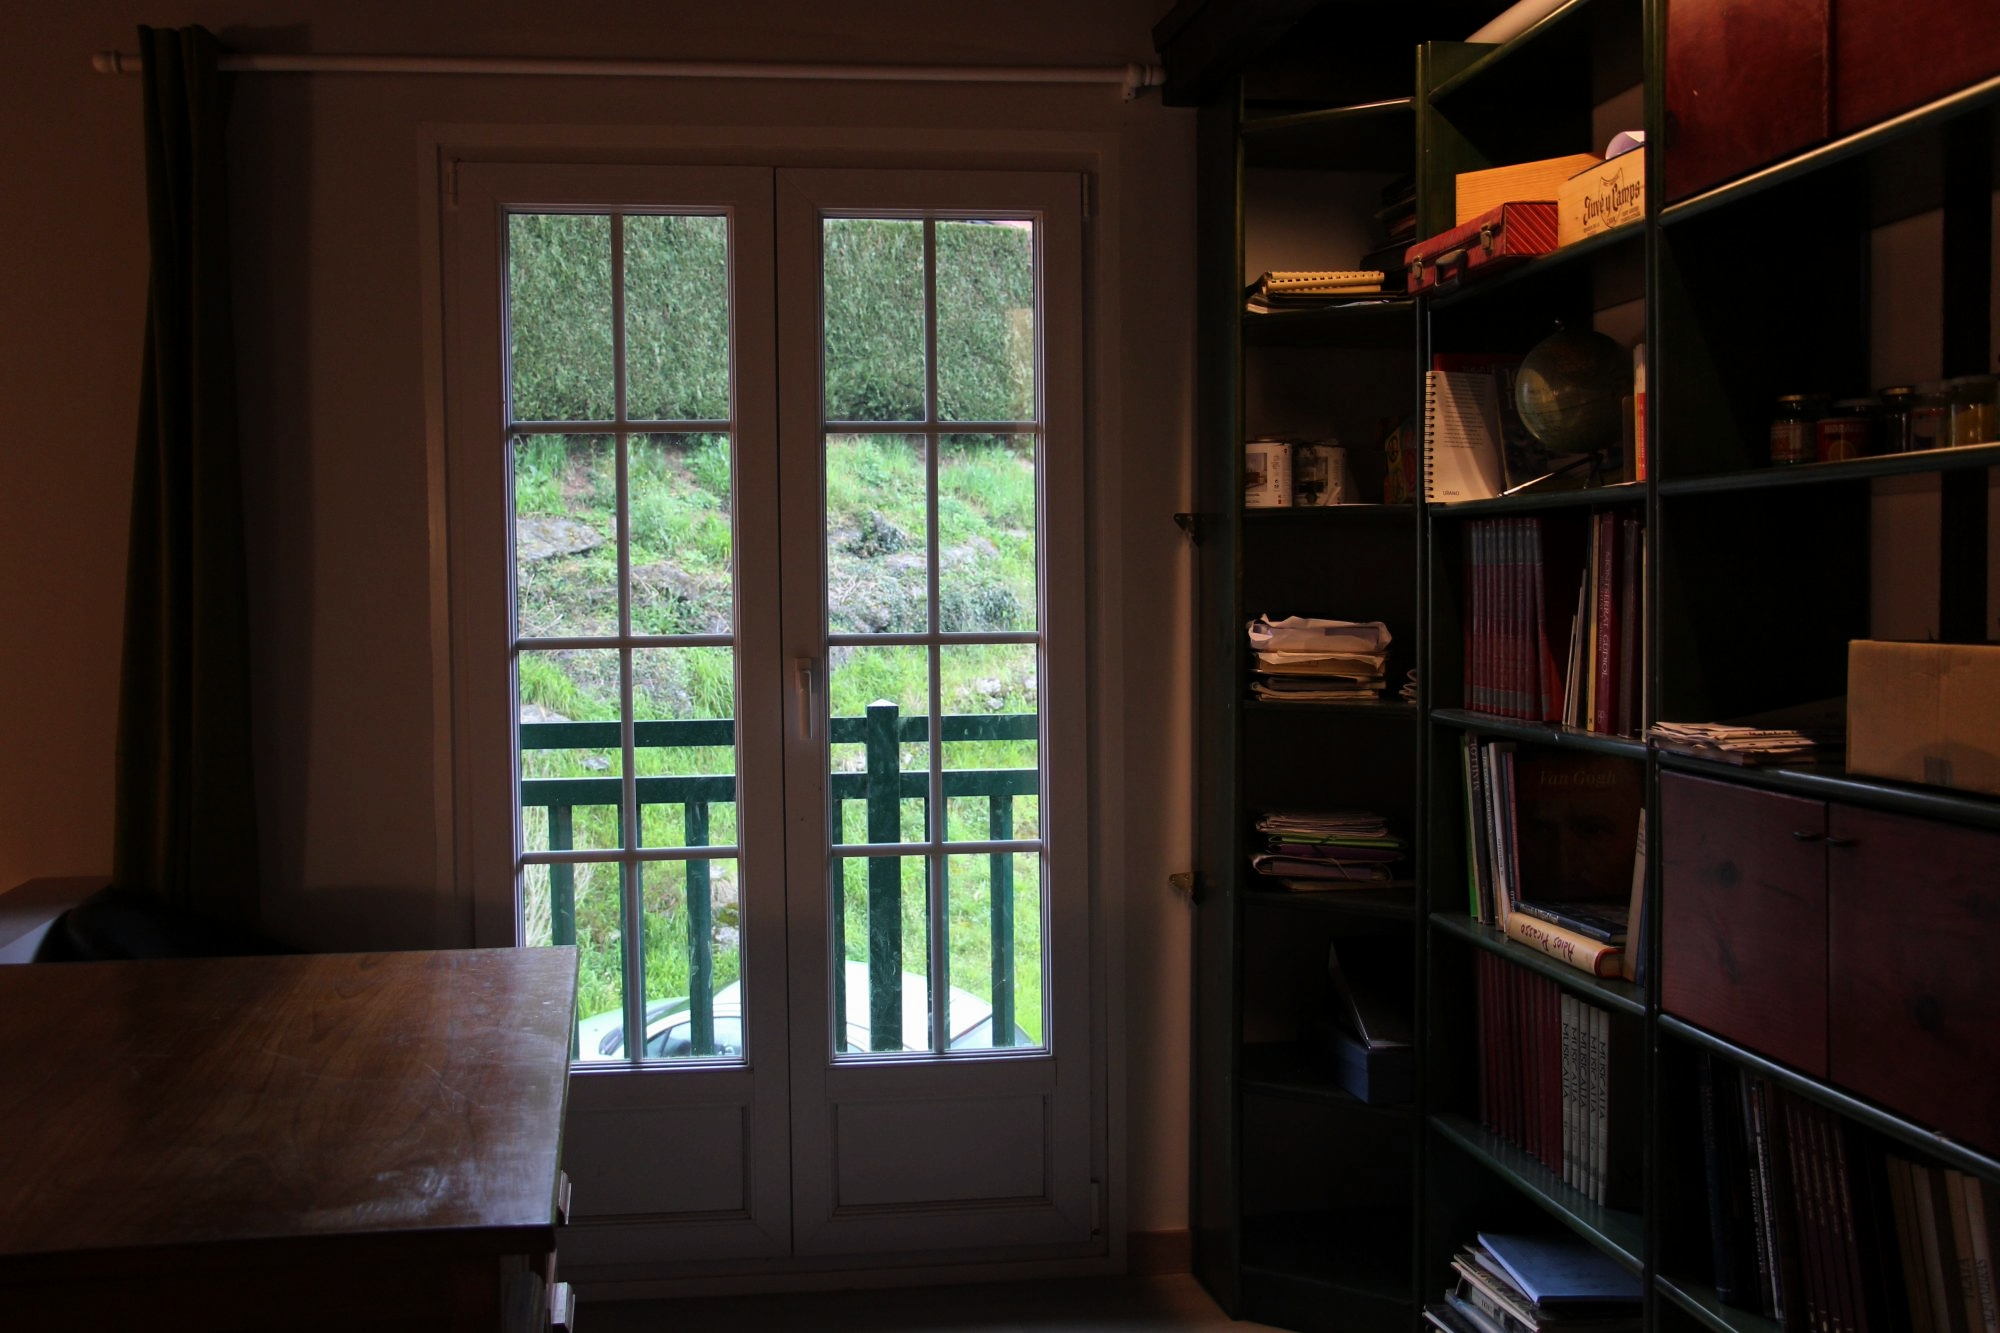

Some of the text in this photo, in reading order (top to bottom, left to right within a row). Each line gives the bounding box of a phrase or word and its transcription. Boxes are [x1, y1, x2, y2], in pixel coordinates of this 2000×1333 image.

[1612, 180, 1640, 212] Camps
[1603, 551, 1611, 627] MONTSERRAT
[1539, 769, 1617, 786] Van Gogh
[1520, 924, 1549, 952] Picasso
